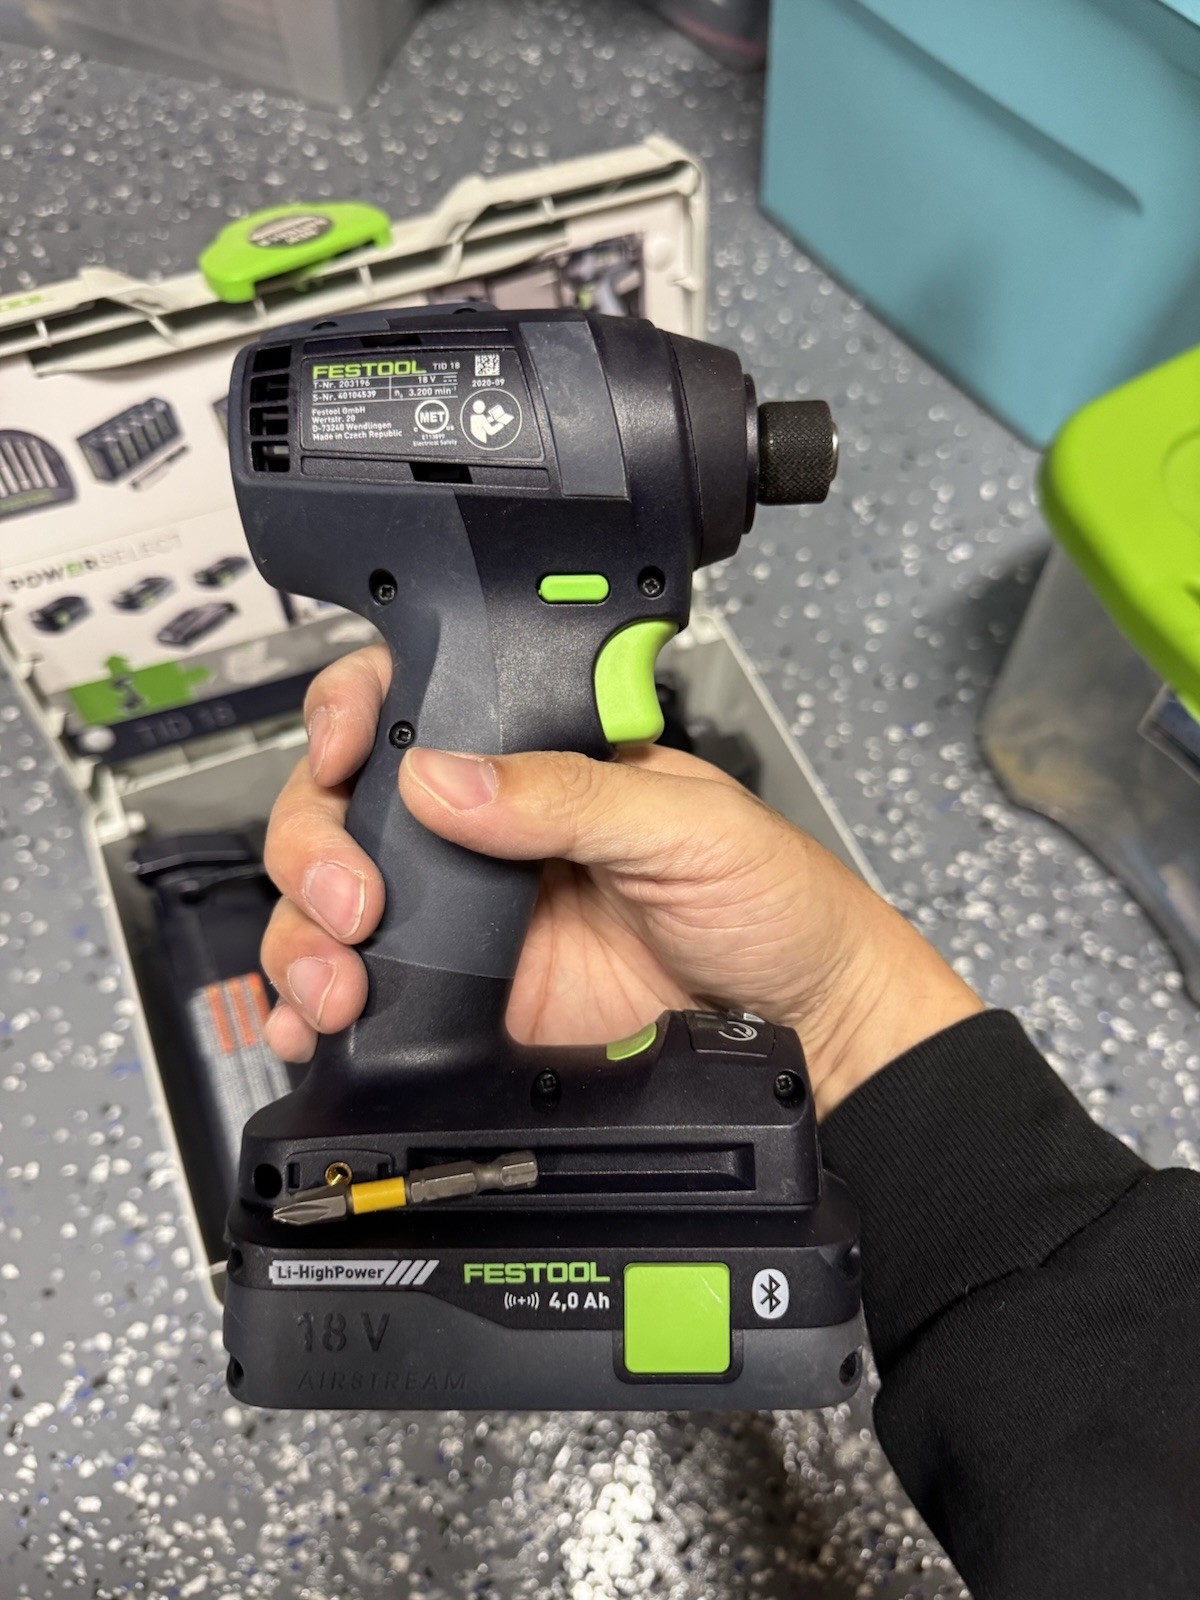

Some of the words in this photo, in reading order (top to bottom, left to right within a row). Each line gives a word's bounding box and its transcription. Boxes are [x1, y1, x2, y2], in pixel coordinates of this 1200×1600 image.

[312, 360, 428, 380] FESTOOL
[432, 362, 448, 371] TID
[450, 361, 461, 370] 18
[313, 381, 336, 390] T-Nr.
[339, 379, 370, 389] 203196
[418, 376, 428, 384] 18
[430, 375, 437, 383] V
[472, 378, 506, 388] 2020-09
[312, 393, 337, 402] S-Nr.
[338, 390, 377, 400] 40104539
[408, 387, 433, 397] 3.200
[312, 407, 341, 417] Festool
[342, 405, 366, 415] GmbH
[312, 415, 345, 425] Wertstr.
[346, 414, 356, 423] 20
[419, 411, 446, 424] MET
[312, 424, 345, 433] D-73240
[346, 421, 392, 432] Wendlingen
[312, 431, 334, 441] Made
[335, 430, 343, 440] in
[344, 429, 367, 440] Czech
[368, 428, 403, 439] Republic
[412, 439, 440, 448] Electrical
[440, 438, 458, 447] Safety
[277, 1264, 385, 1282] Li-HighPower
[463, 1262, 611, 1284] FESTOOL
[549, 1291, 579, 1312] 4,0
[583, 1291, 610, 1309] Ah
[297, 1311, 347, 1352] 18
[360, 1311, 391, 1352] V
[297, 1370, 468, 1391] AIRSTREAM
